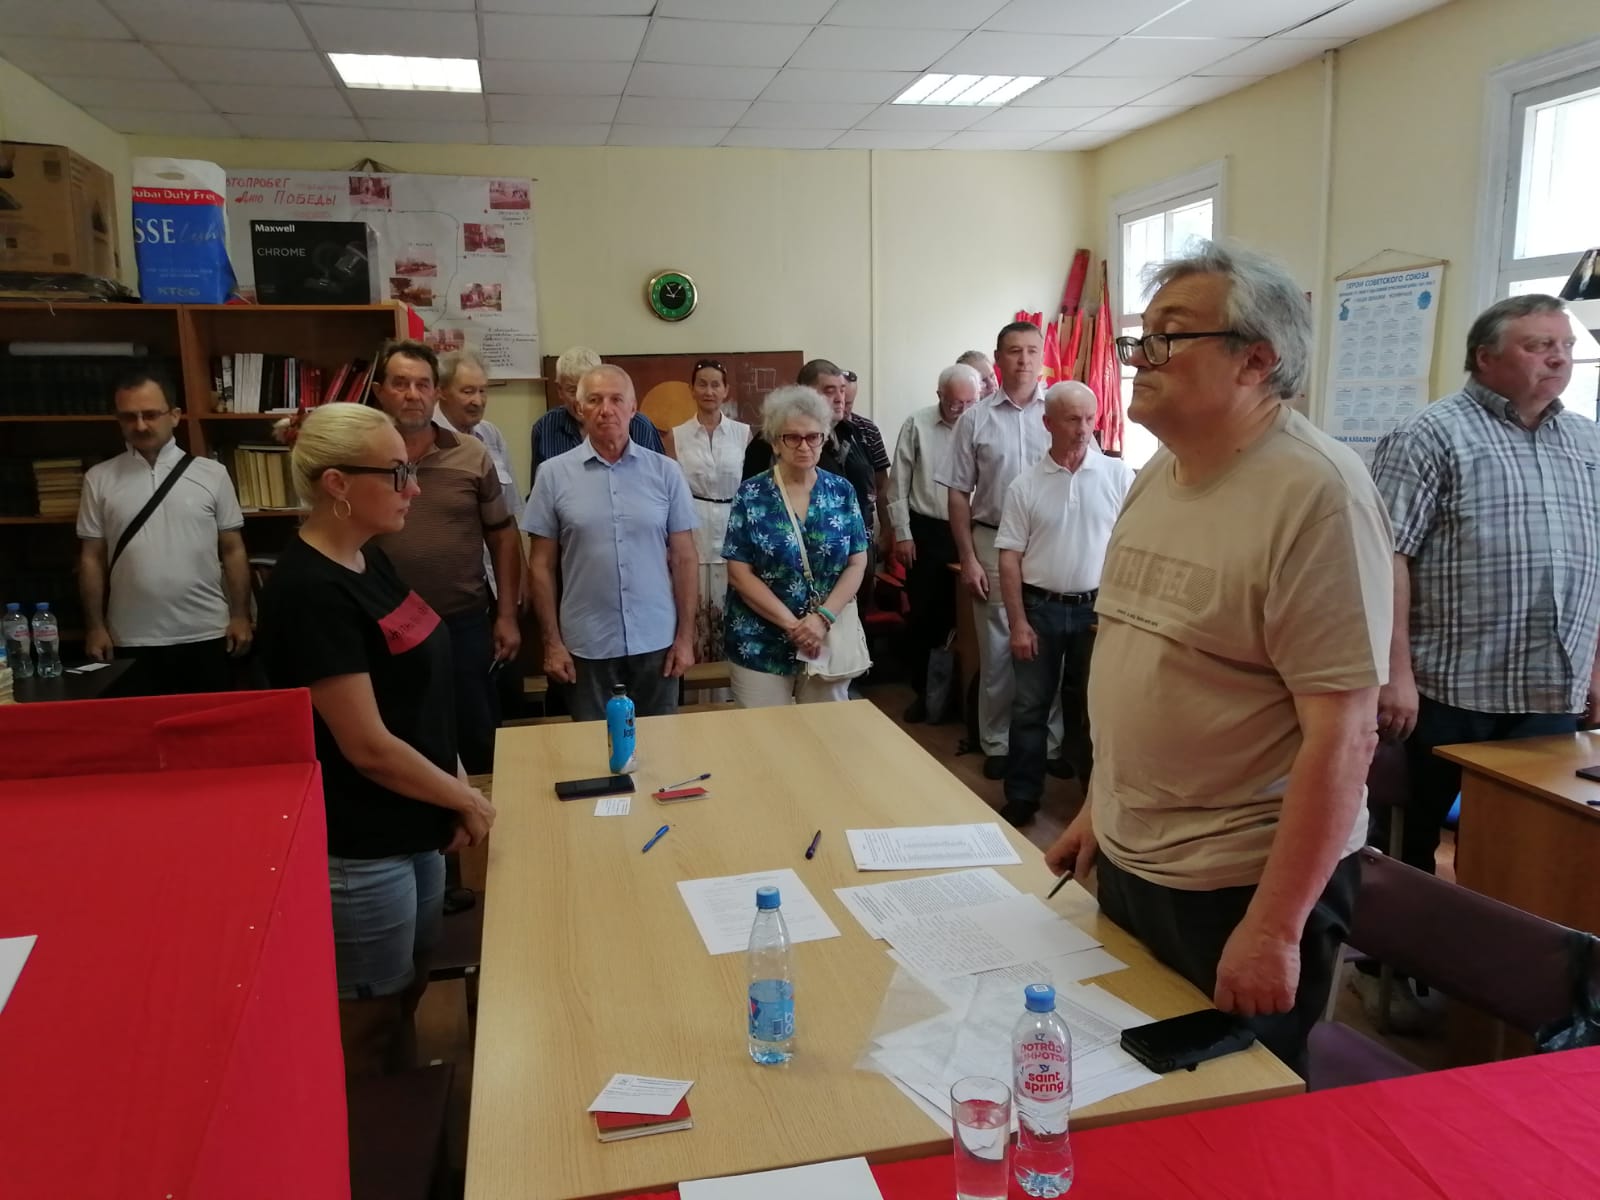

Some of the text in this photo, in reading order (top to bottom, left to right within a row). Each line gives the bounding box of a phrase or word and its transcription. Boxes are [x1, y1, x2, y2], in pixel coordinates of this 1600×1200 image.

[164, 190, 191, 201] Duty
[255, 224, 296, 233] Maxwell
[257, 248, 307, 257] CHROME
[1028, 1071, 1061, 1082] saint
[1024, 1080, 1064, 1094] spring
